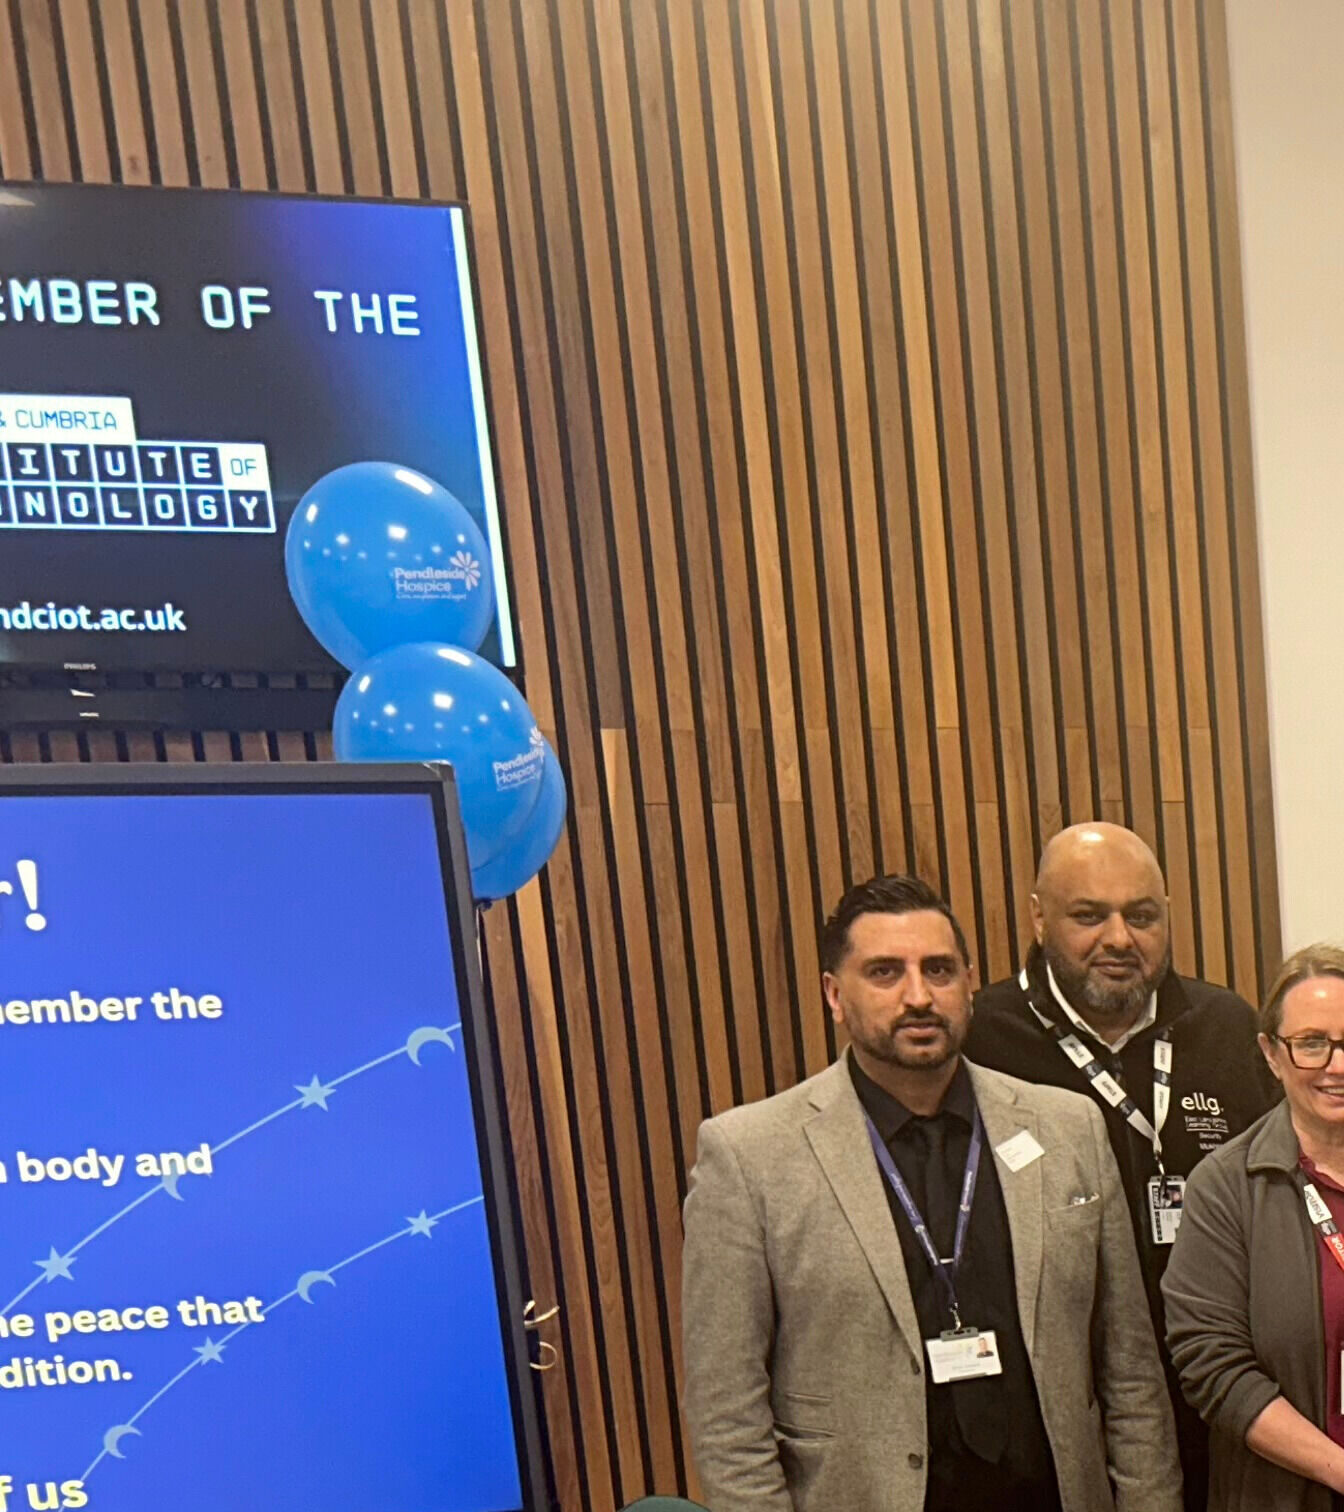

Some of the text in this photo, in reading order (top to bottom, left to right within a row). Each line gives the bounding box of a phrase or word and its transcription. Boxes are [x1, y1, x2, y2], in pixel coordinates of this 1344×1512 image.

[0, 278, 420, 336] MBER OF THE
[15, 409, 117, 430] CUMBRIA
[230, 458, 257, 476] OF
[0, 491, 258, 521] NOLOGY
[396, 580, 452, 592] Hospice
[0, 988, 223, 1025] ember the
[16, 1150, 124, 1187] body
[136, 1143, 213, 1177] and
[45, 1305, 169, 1343] peace
[177, 1296, 265, 1327] that
[0, 1355, 133, 1389] dition.
[26, 1480, 88, 1511] us
